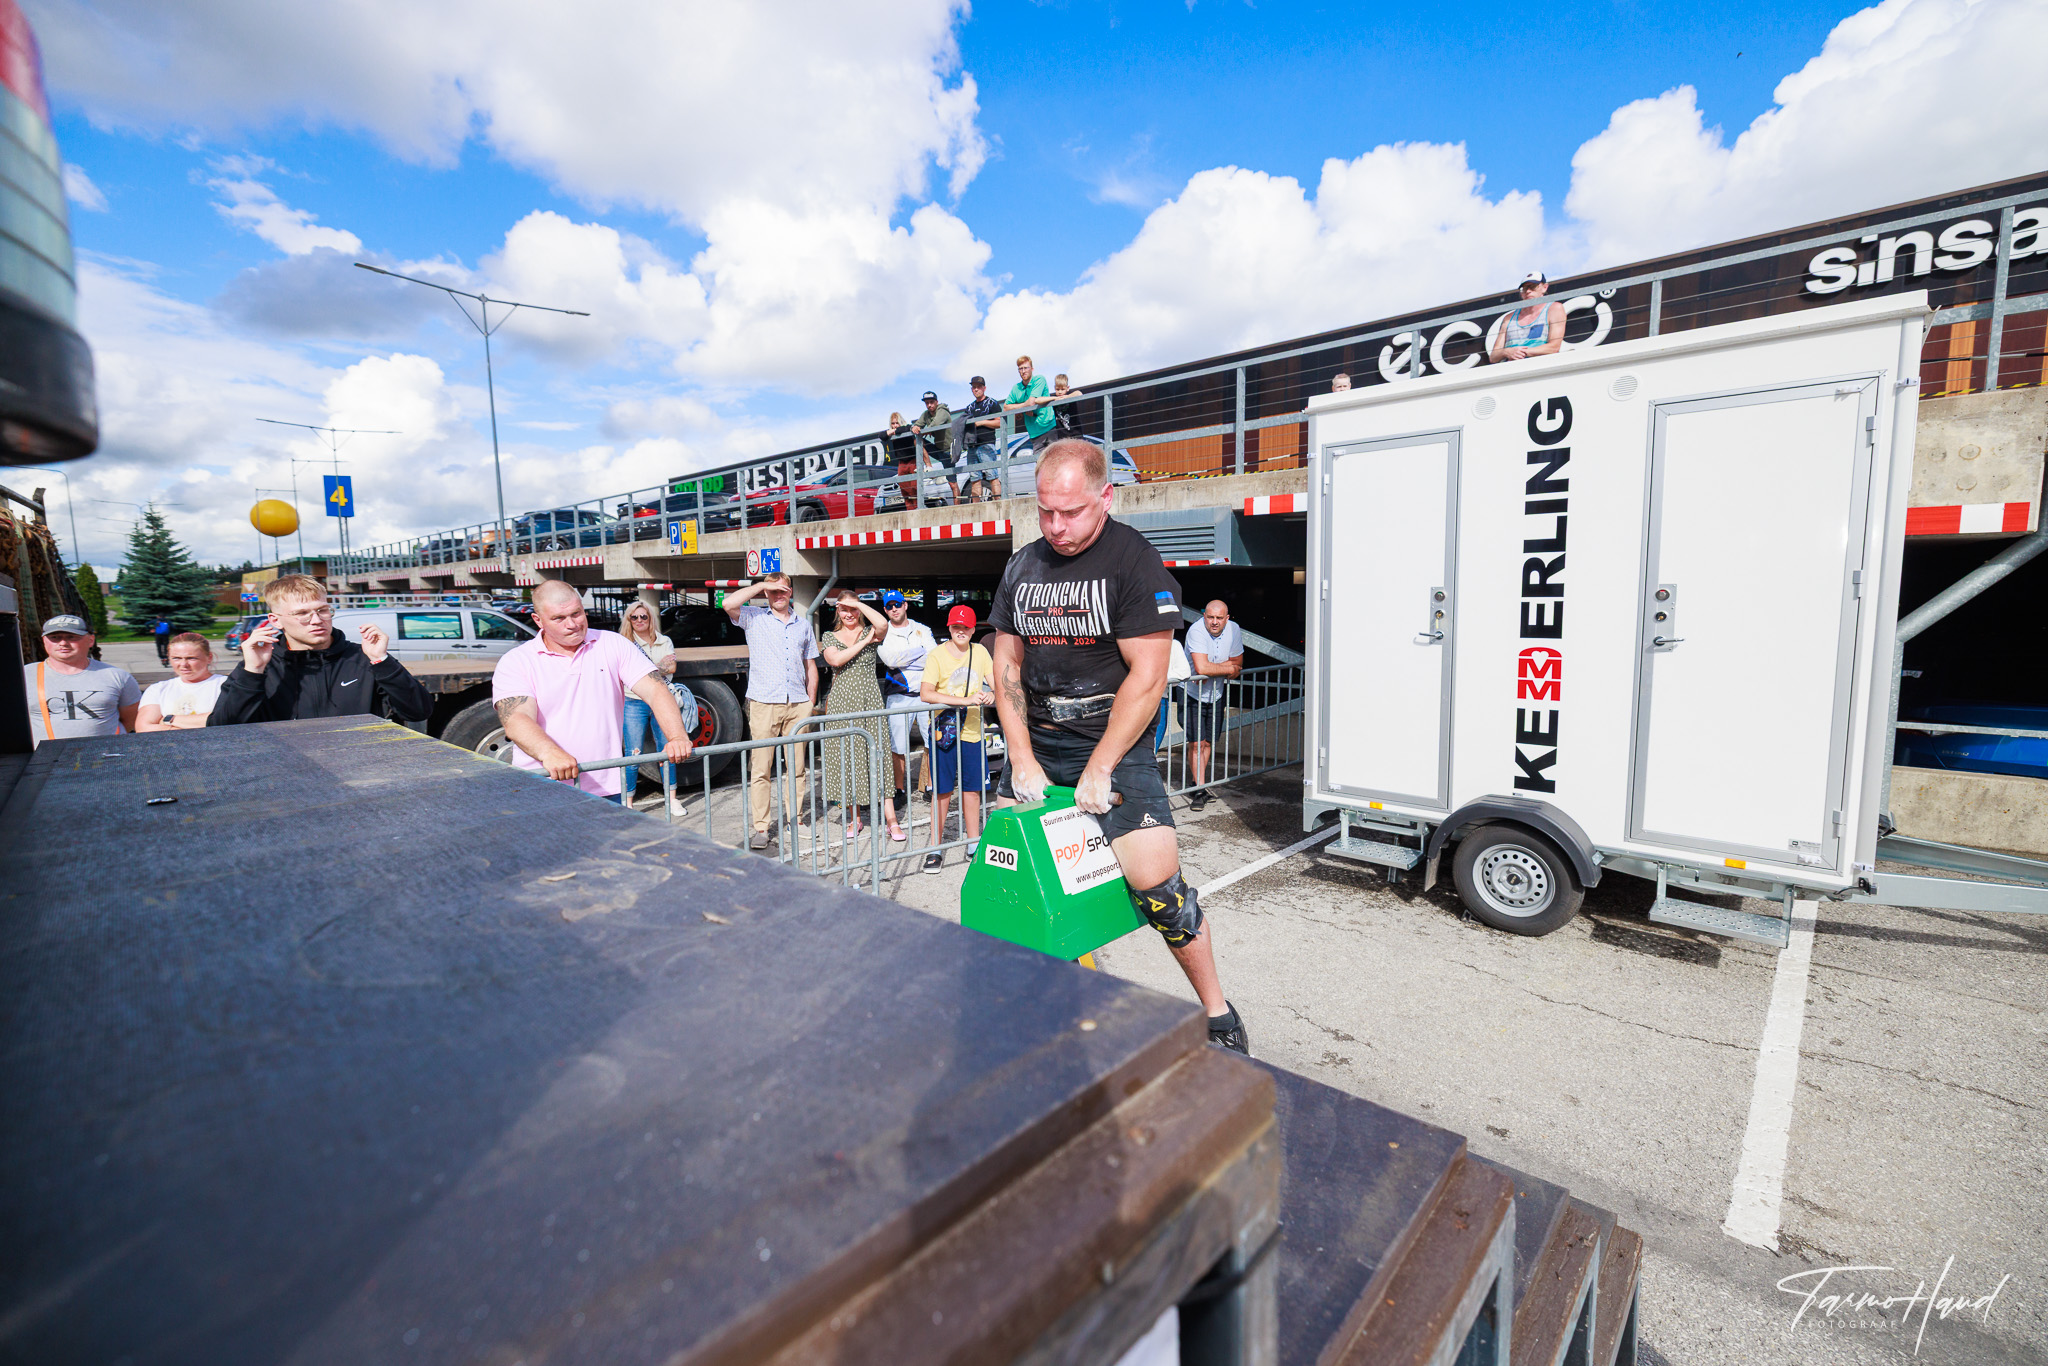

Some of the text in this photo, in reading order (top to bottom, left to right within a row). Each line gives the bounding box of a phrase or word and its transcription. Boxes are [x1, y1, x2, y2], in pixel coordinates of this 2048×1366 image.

[737, 442, 885, 493] RESERVED
[329, 486, 348, 506] 4
[670, 525, 678, 543] P
[1048, 607, 1064, 616] PRO
[1029, 636, 1096, 645] ESTONIA 2026
[1043, 816, 1064, 826] Suurim
[989, 849, 1014, 866] 200
[1055, 843, 1080, 863] POP
[1075, 861, 1122, 884] www.popsport.
